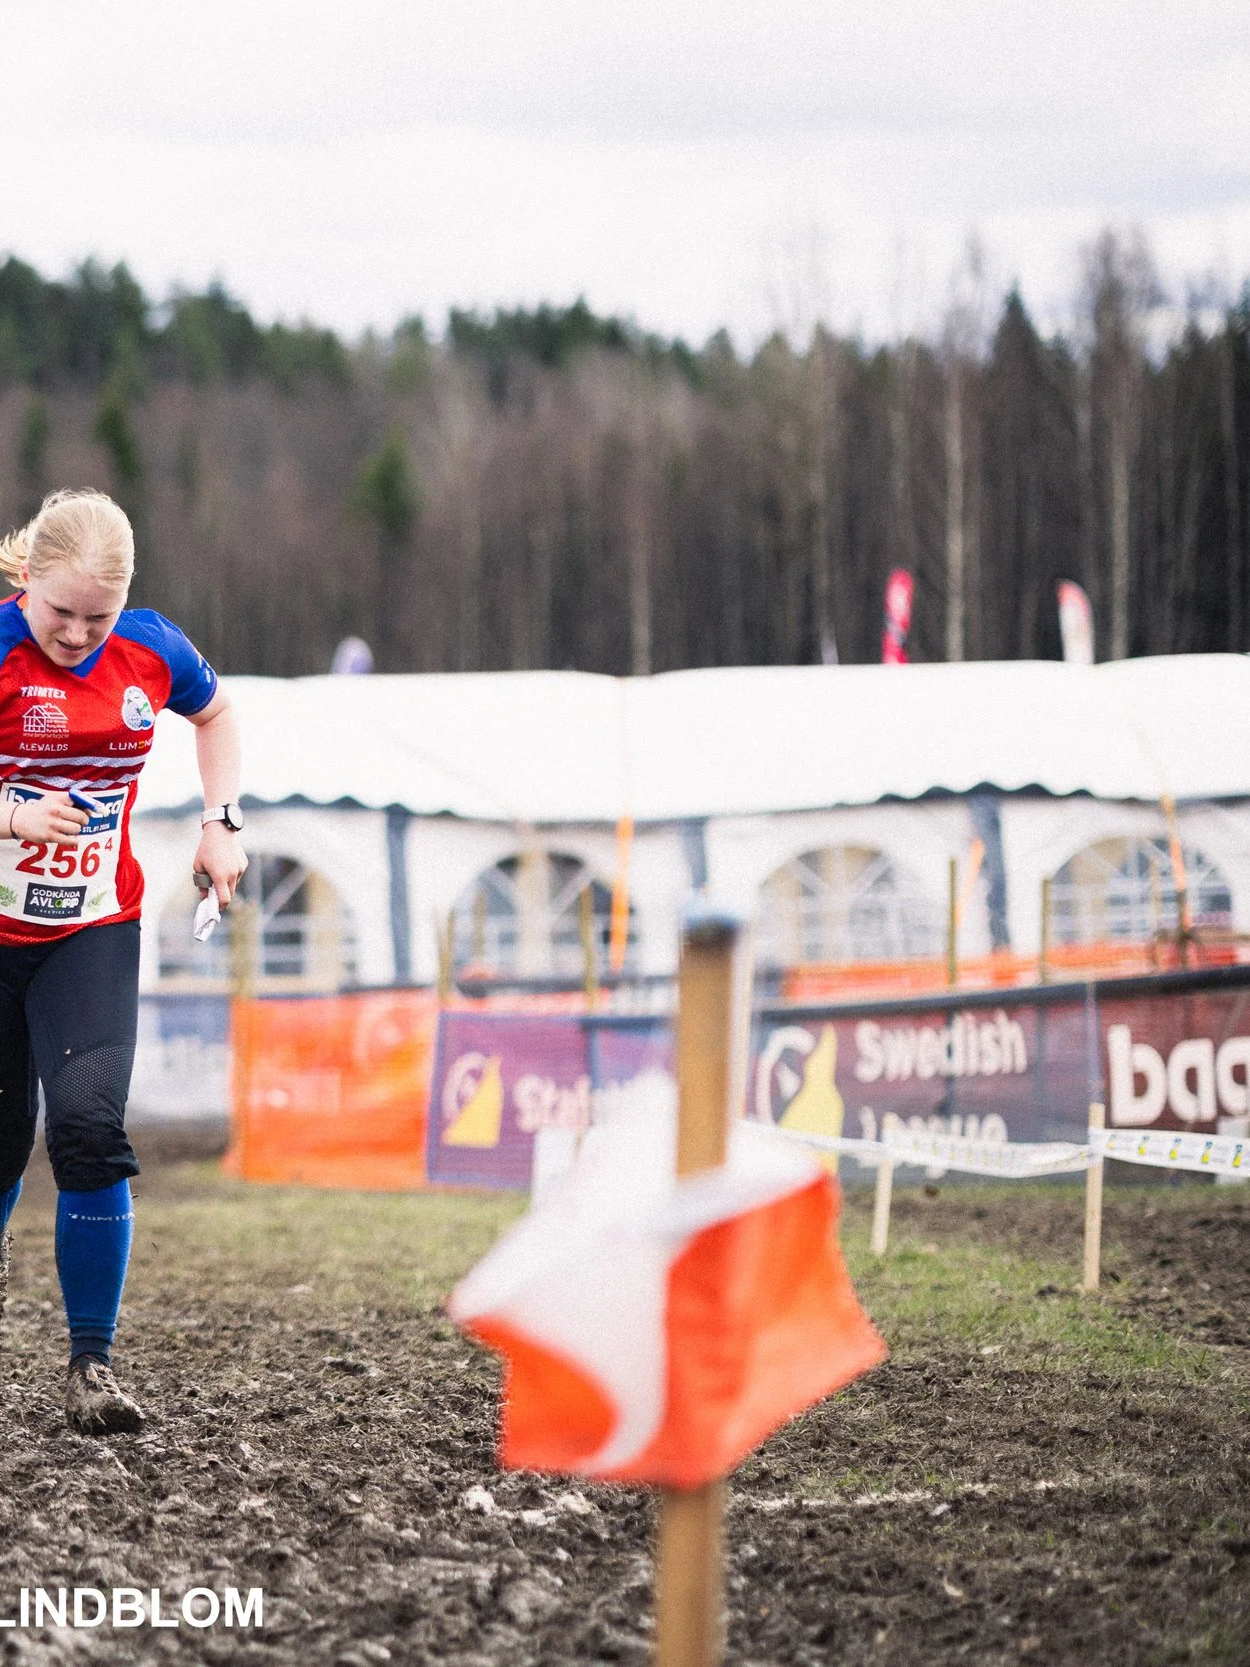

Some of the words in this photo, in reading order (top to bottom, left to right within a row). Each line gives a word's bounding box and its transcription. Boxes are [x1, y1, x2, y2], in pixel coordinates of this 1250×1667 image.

[21, 686, 67, 699] TRIMTEX
[19, 742, 68, 752] ALEWALDS
[15, 840, 100, 878] 256
[104, 837, 113, 852] 4
[31, 888, 80, 898] GODKÄNDA
[30, 896, 79, 908] AVLOPP
[854, 1008, 1028, 1083] Swedish
